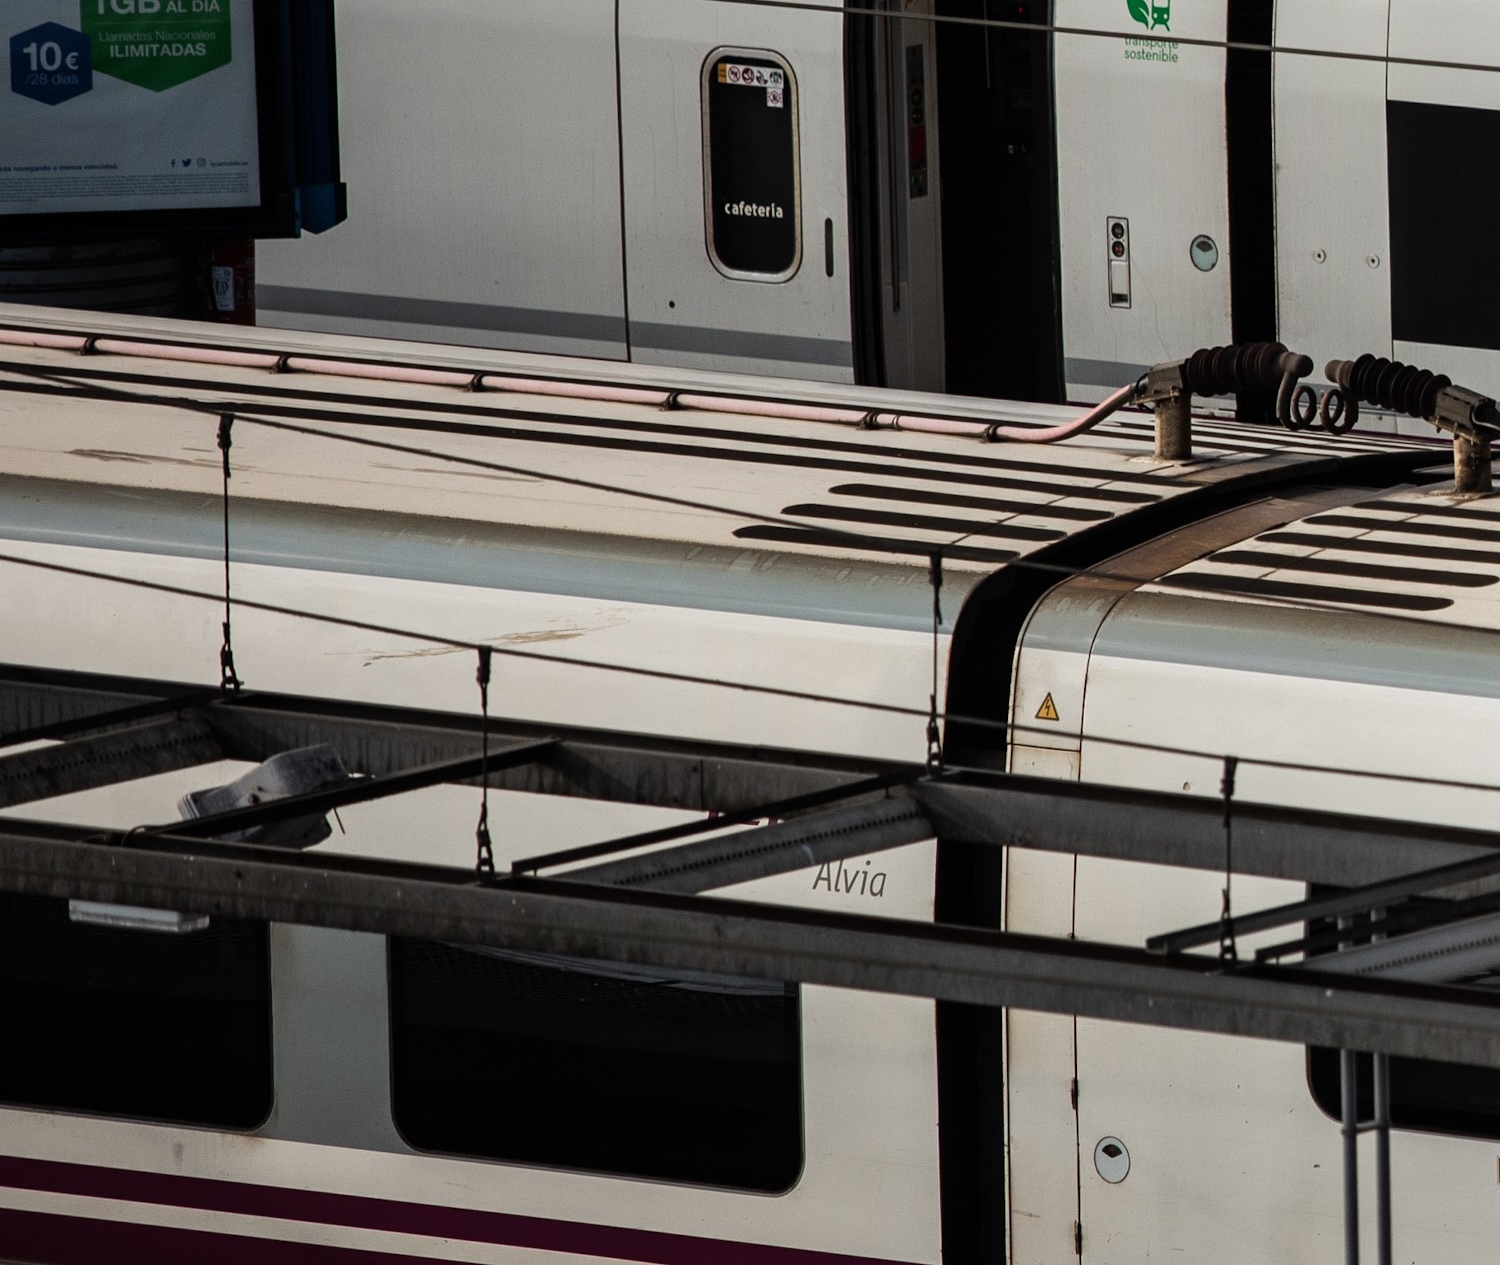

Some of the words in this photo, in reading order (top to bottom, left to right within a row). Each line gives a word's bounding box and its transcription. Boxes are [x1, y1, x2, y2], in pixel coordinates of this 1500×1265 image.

[166, 0, 187, 13] AL
[99, 31, 152, 42] Llamadas
[155, 30, 216, 41] Nacionales
[109, 43, 207, 58] ILIMITADAS
[1124, 48, 1179, 63] sostenible
[812, 858, 887, 897] Alvia
